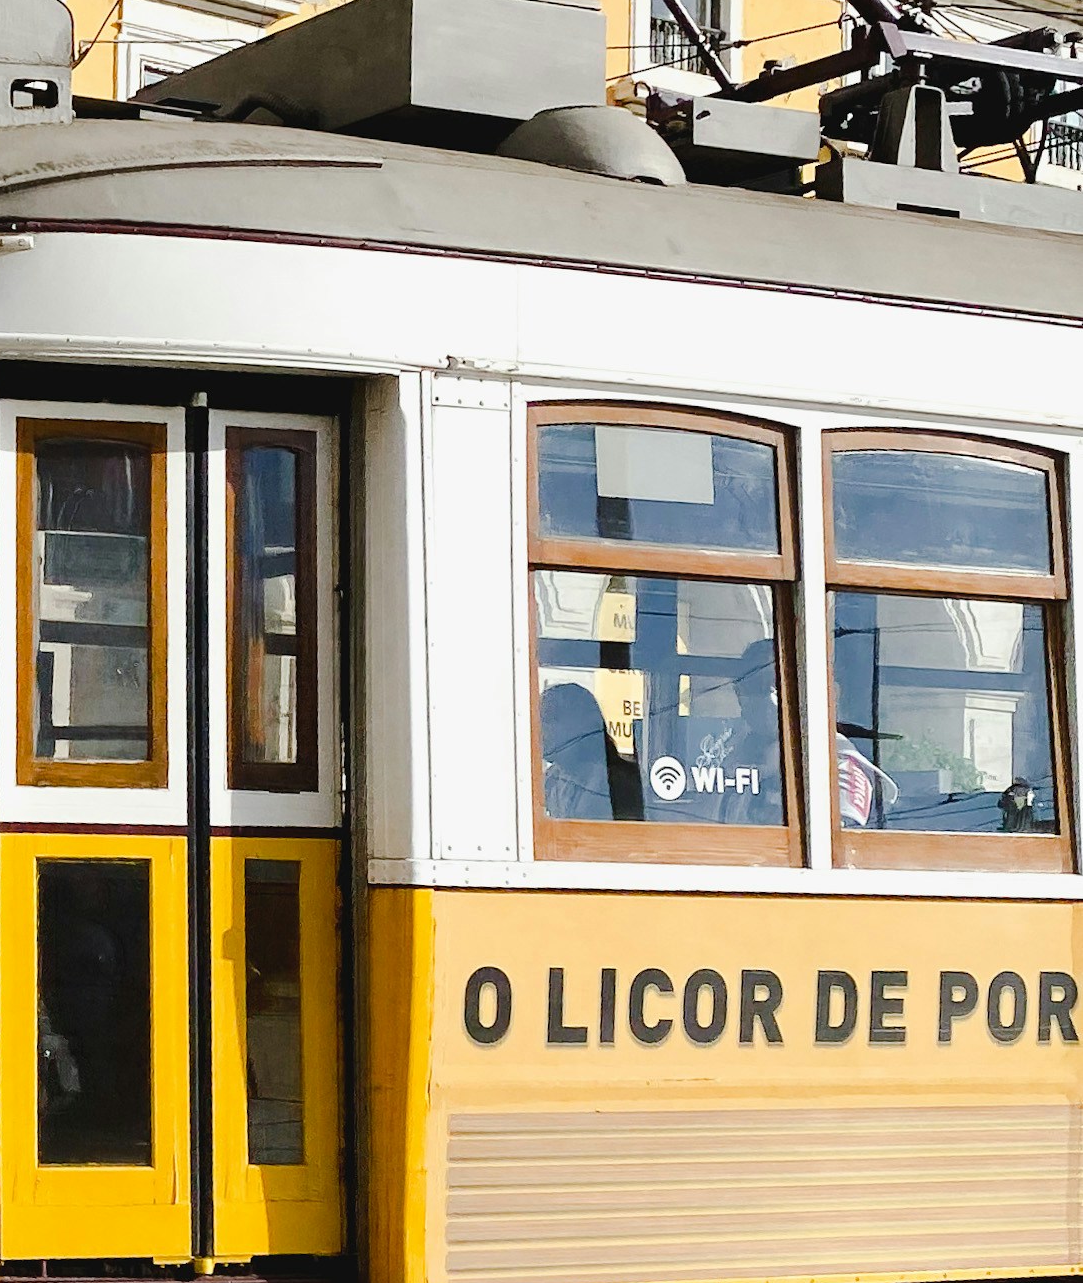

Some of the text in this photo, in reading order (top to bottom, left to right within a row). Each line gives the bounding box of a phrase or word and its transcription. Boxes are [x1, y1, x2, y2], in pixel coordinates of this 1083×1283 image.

[690, 766, 760, 795] WI-FI
[464, 966, 1080, 1044] O LICOR DE POR
